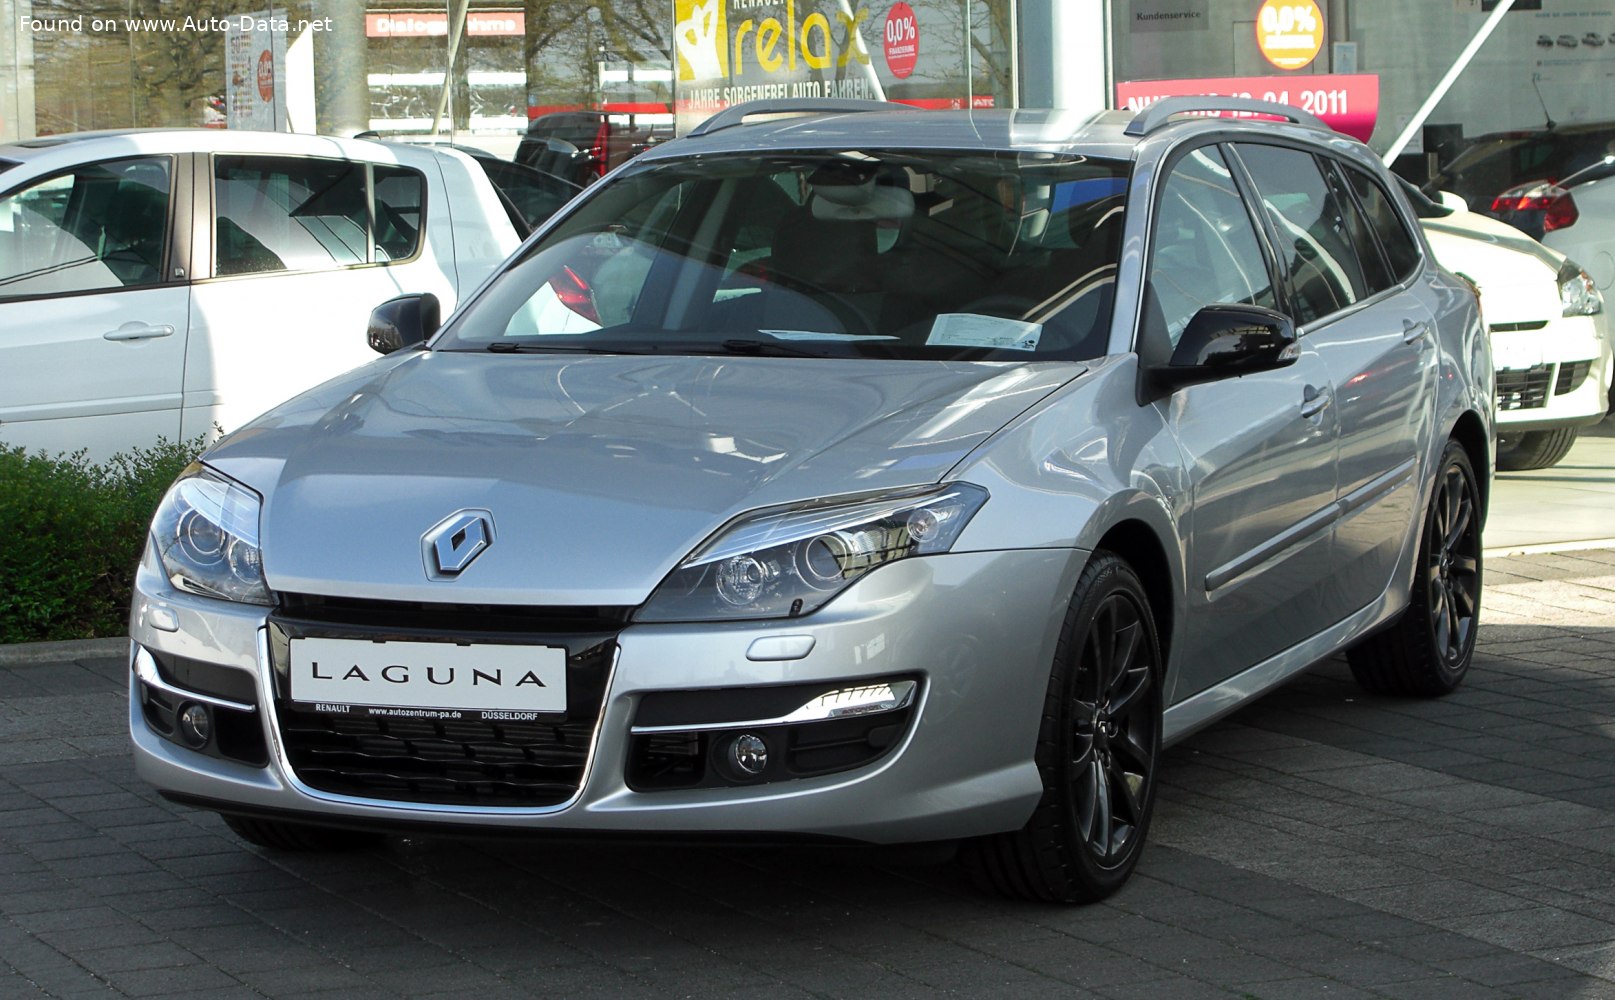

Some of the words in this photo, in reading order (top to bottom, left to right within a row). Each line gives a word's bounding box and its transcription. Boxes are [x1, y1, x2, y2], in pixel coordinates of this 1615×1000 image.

[886, 16, 916, 46] 0,0%
[1136, 11, 1201, 21] Kundenservice
[1261, 6, 1317, 36] 0,0%
[735, 0, 870, 75] relax
[688, 88, 721, 110] JAHRE
[723, 83, 788, 108] SORGENFREI
[792, 80, 821, 99] AUTO
[311, 661, 547, 687] LAGUNA
[315, 703, 351, 713] RENAULT
[368, 707, 462, 719] www.autozentrum-pa.de
[481, 709, 538, 720] DÜSSELDORF
